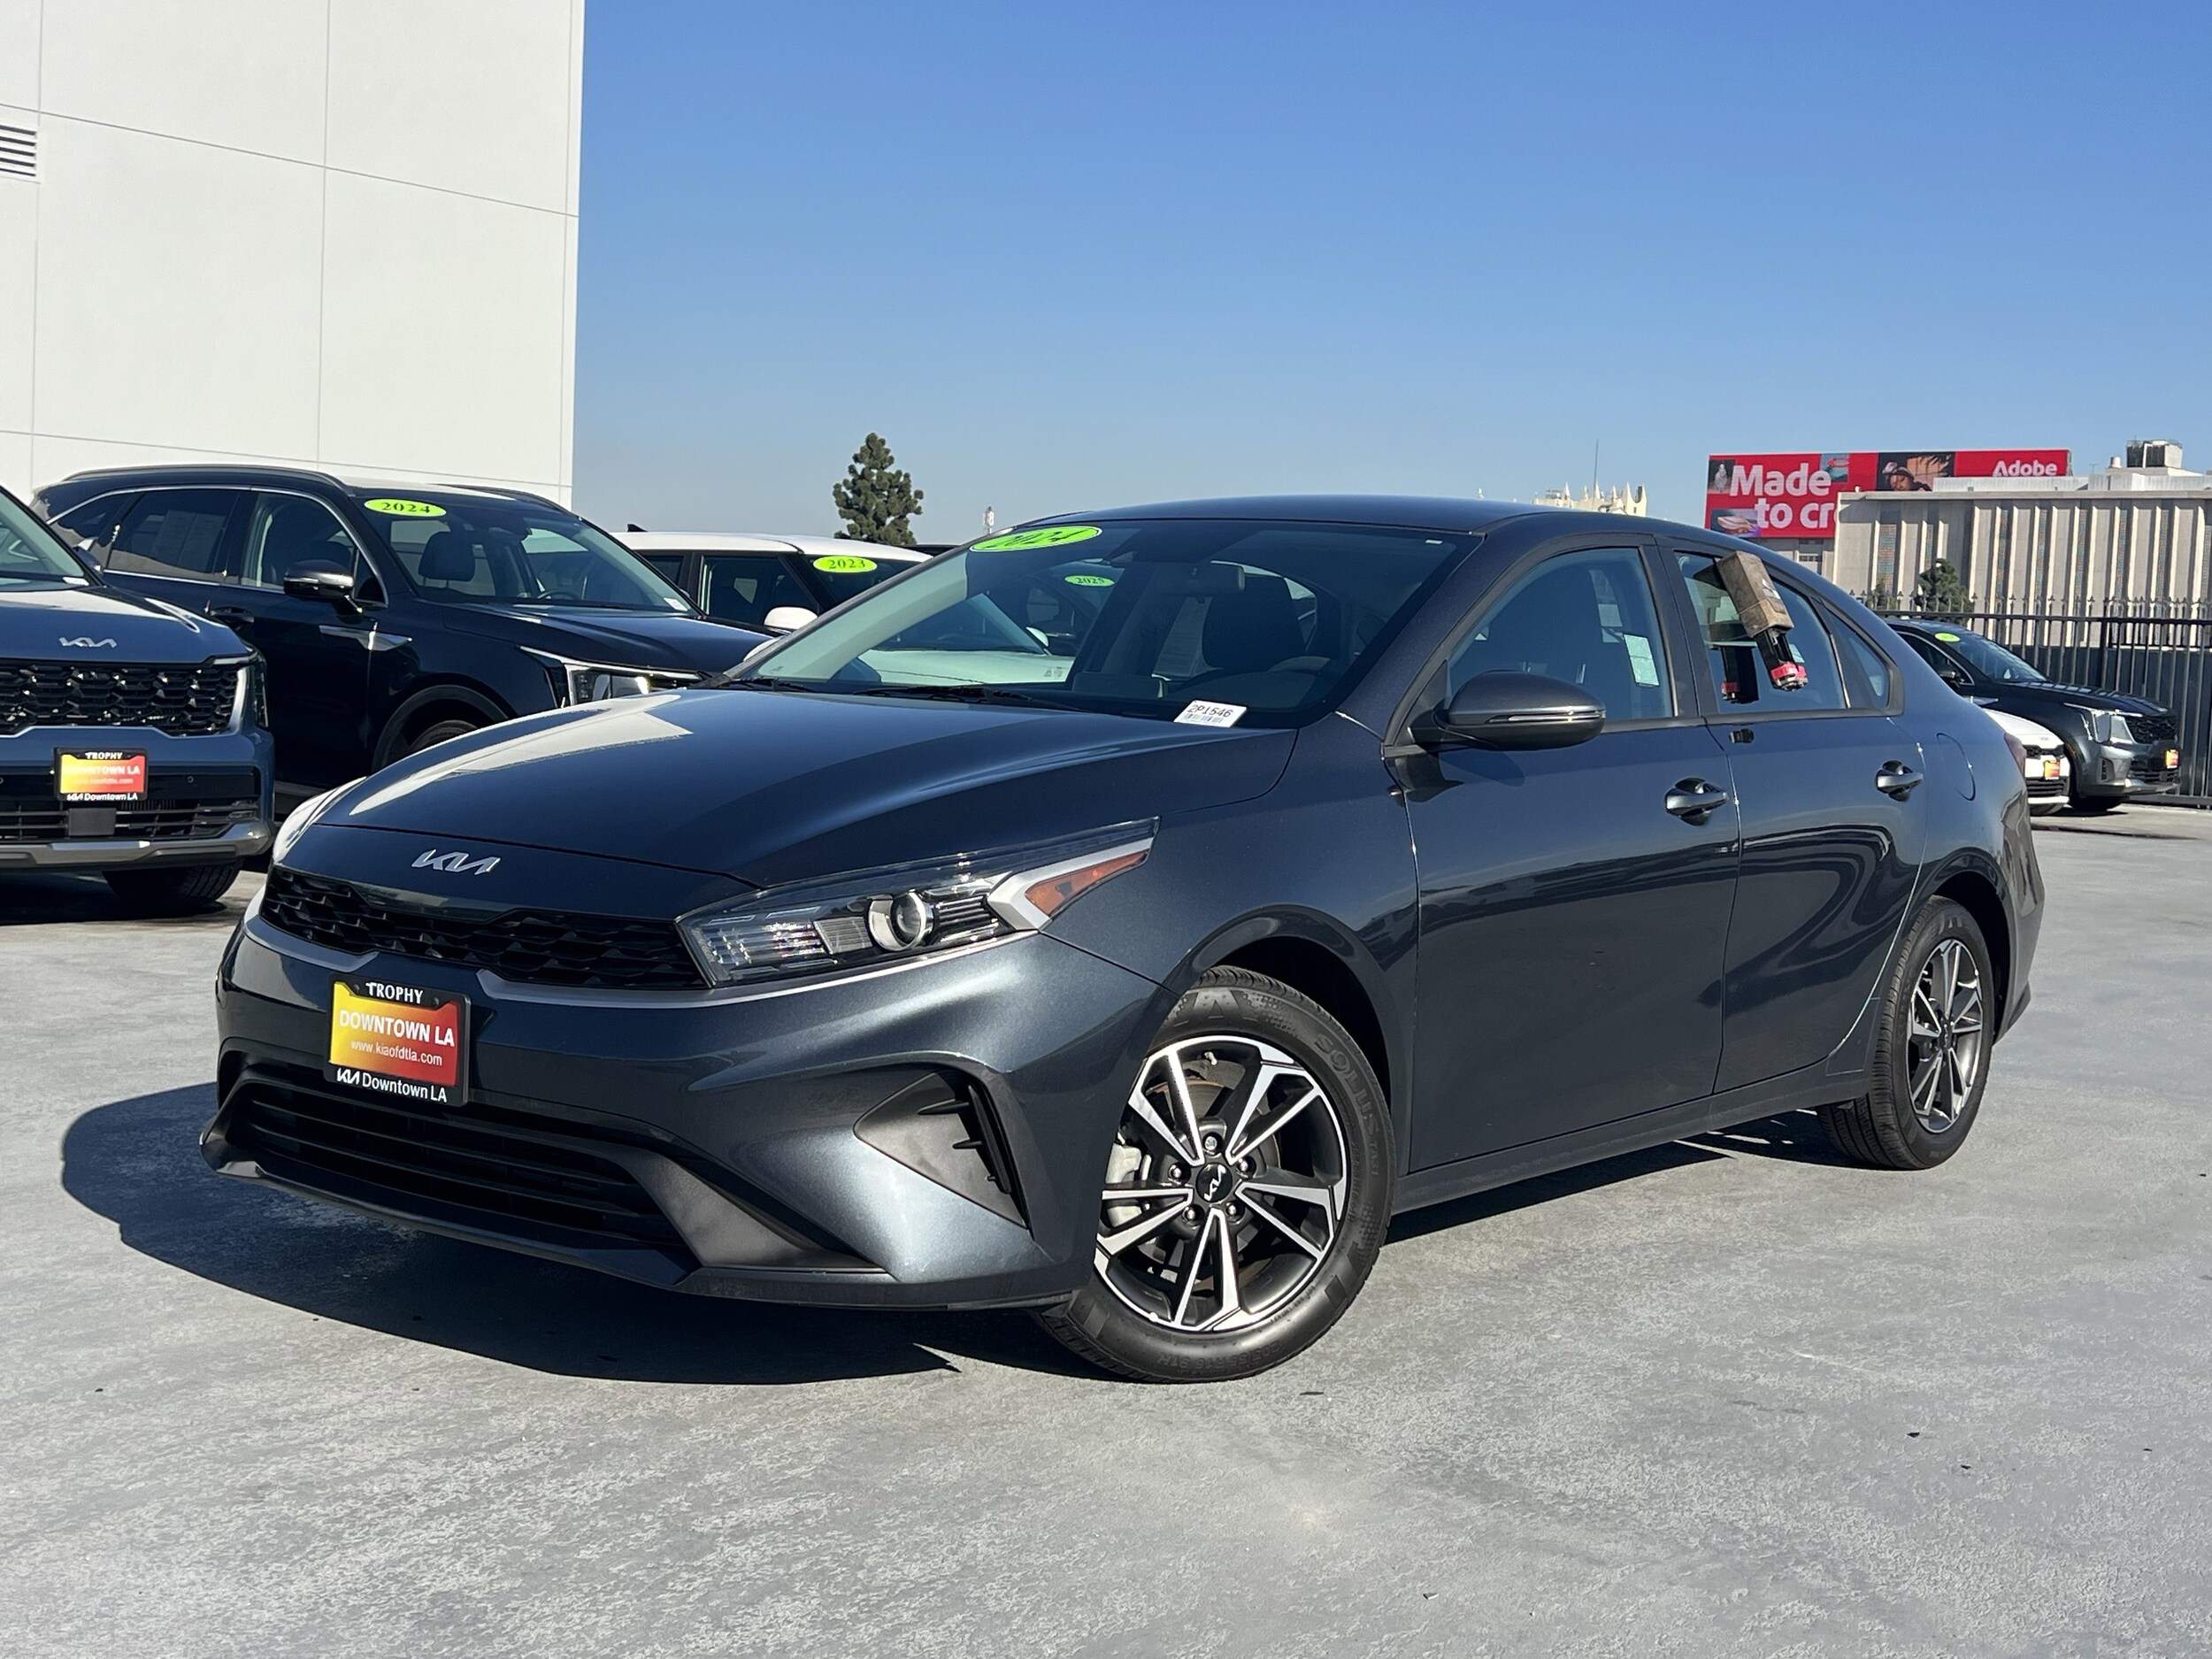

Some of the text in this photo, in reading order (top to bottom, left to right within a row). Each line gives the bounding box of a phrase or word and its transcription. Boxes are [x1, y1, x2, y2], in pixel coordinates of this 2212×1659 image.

[1730, 463, 1832, 496] Made
[1993, 459, 2058, 477] Adobe
[381, 502, 430, 513] 2024
[1755, 497, 1838, 529] to cr
[828, 558, 865, 569] 2023
[1187, 704, 1233, 718] 2P1546
[365, 982, 423, 1004] TROPHY
[339, 1010, 455, 1047] DOWNTOWN LA
[350, 1040, 442, 1066] www.kiaofdtla.com
[363, 1071, 428, 1099] Downtown
[431, 1086, 448, 1103] LA
[1314, 1033, 1379, 1135] SOLUS
